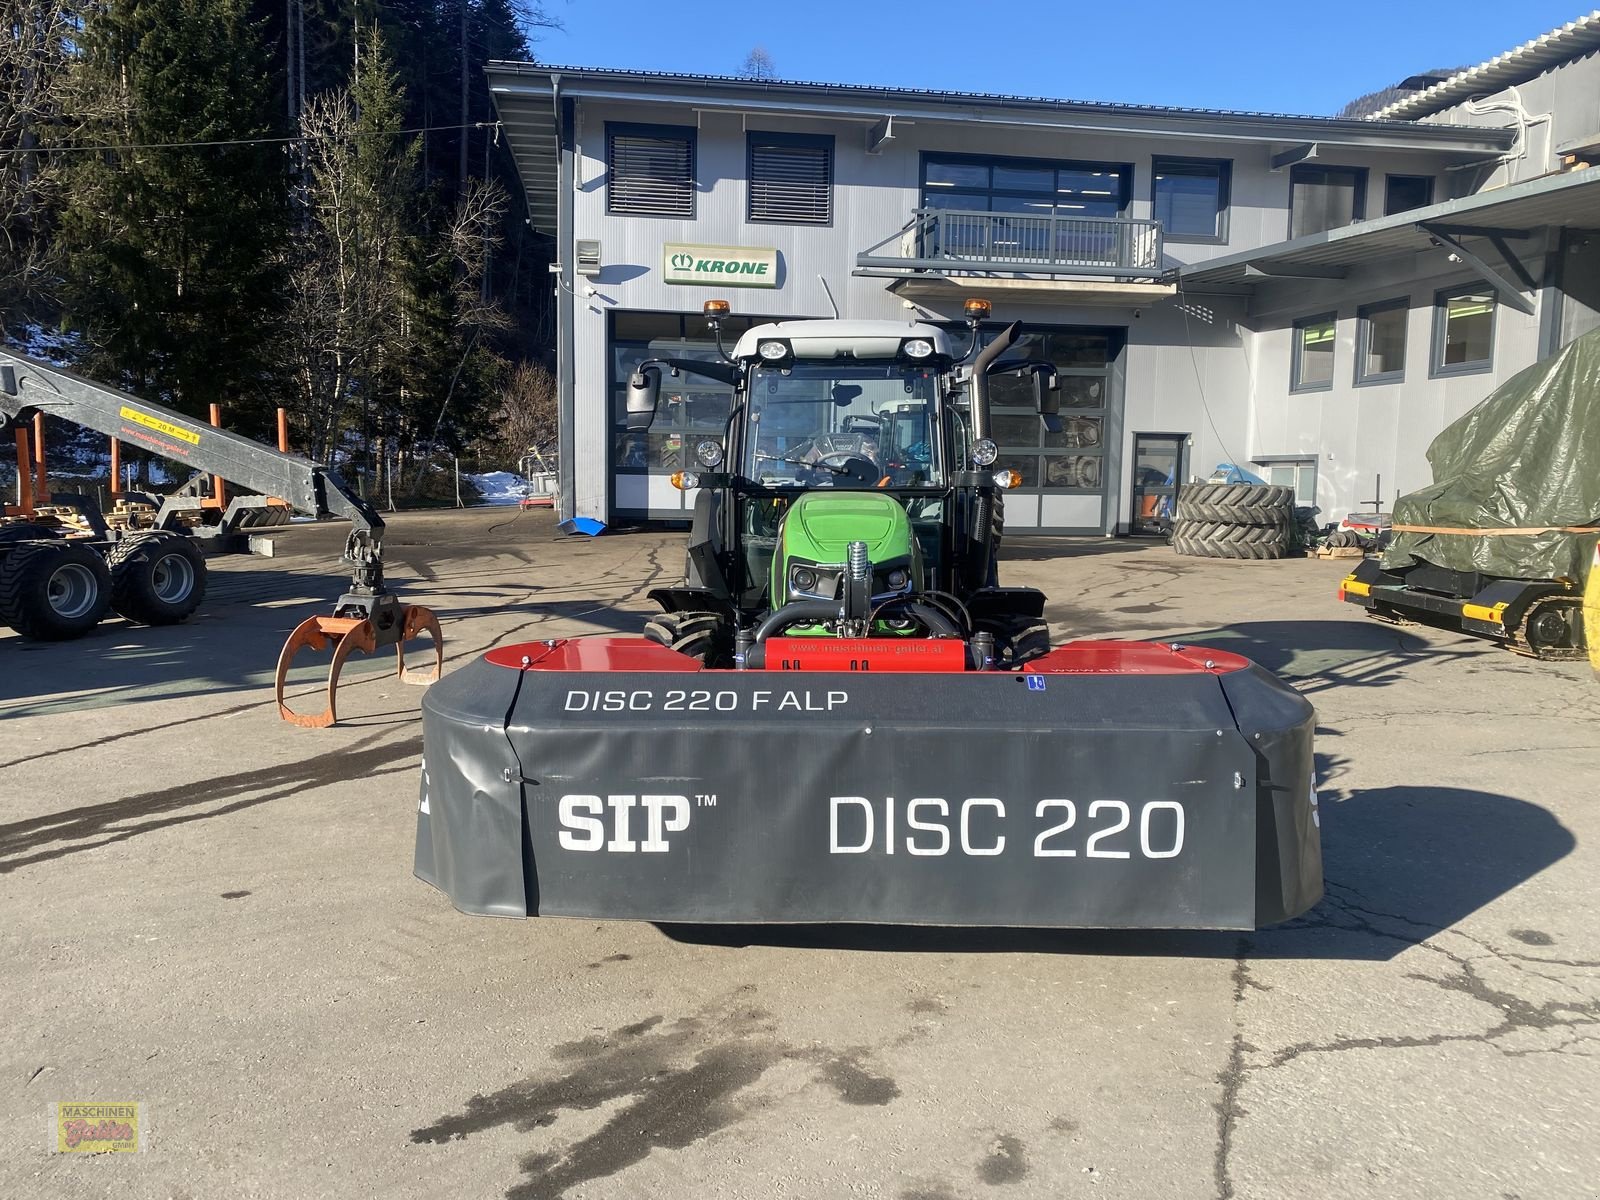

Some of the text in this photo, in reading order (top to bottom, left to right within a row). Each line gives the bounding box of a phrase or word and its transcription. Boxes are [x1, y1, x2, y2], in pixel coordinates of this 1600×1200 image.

[695, 259, 769, 275] KRONE
[157, 422, 167, 431] 20
[564, 690, 653, 711] DISC
[663, 690, 738, 711] 220
[558, 794, 691, 852] SIP
[829, 796, 1185, 859] DISC 220
